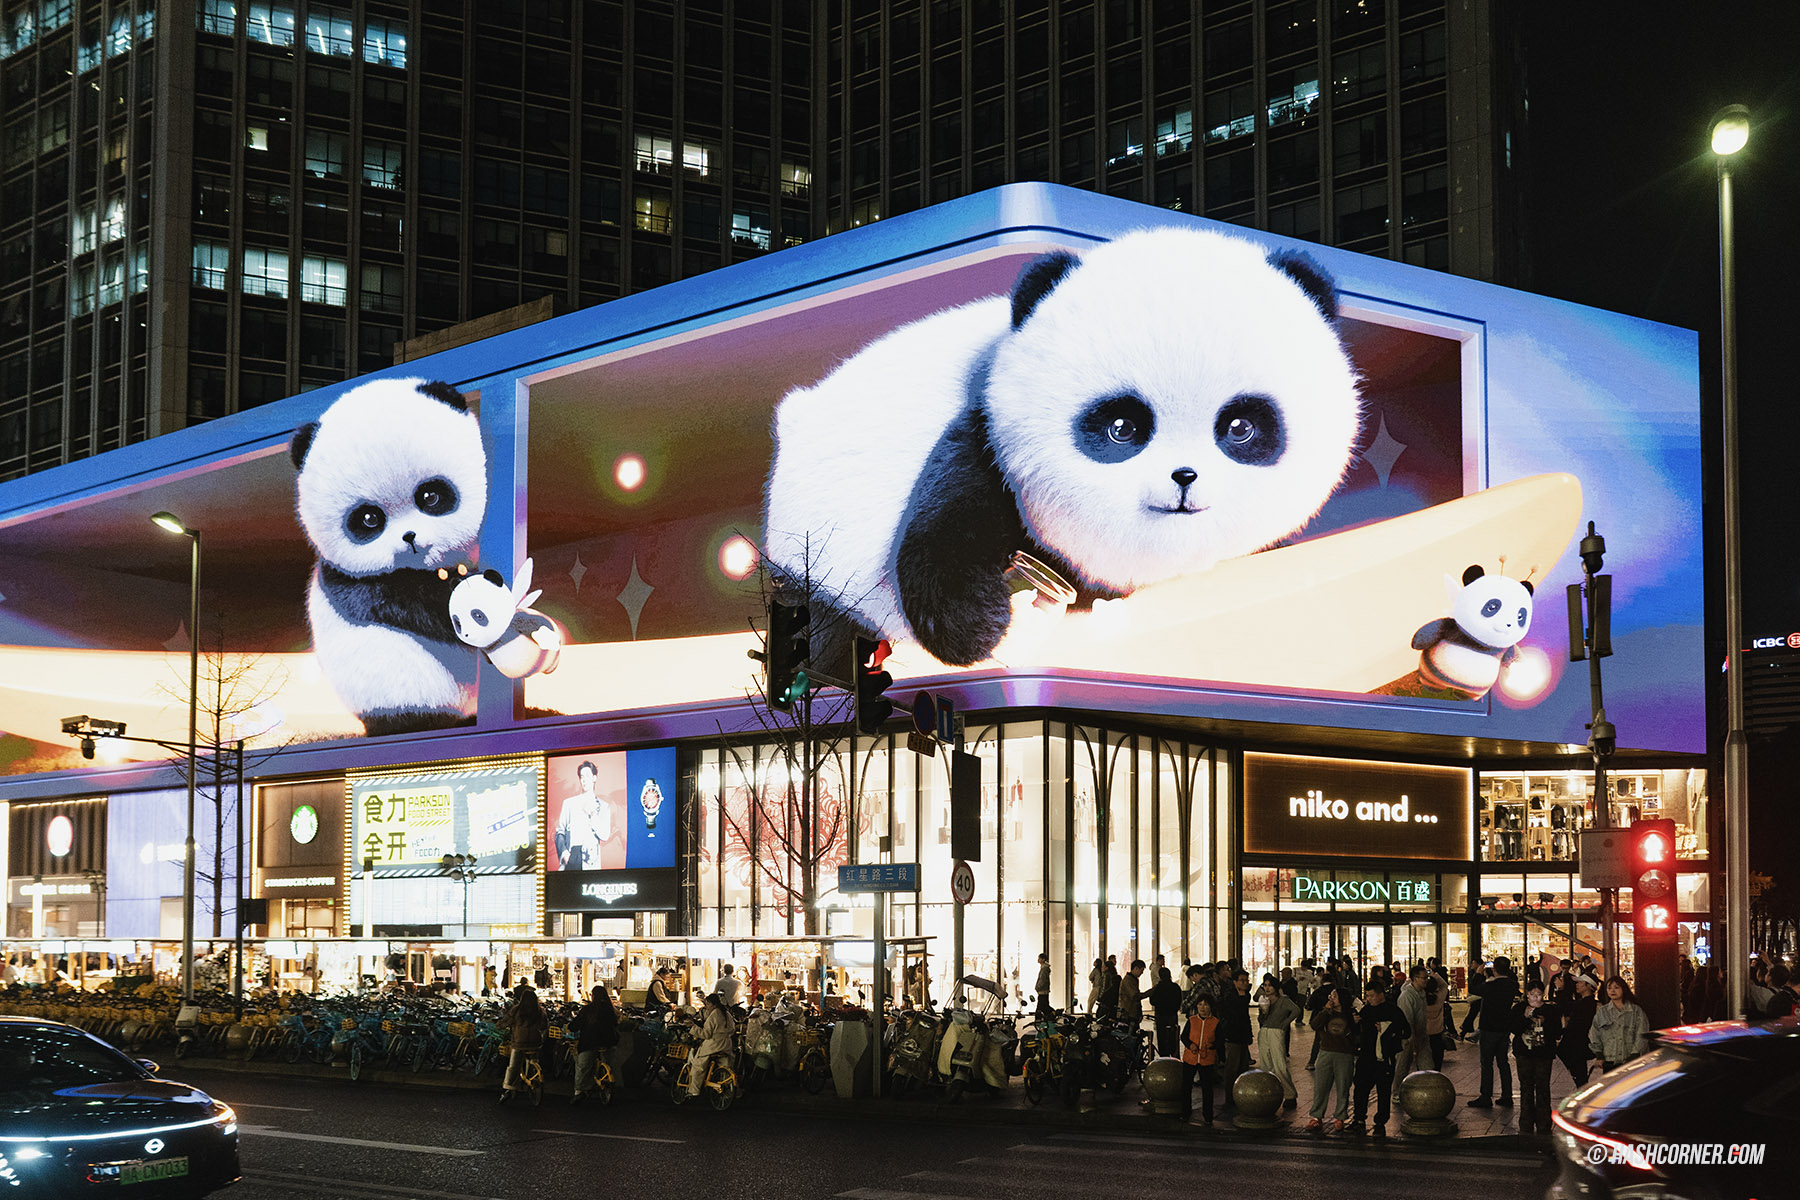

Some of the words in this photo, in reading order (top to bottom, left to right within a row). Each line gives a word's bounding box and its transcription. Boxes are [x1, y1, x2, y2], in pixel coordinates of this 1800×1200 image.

[1753, 637, 1785, 649] ICBC
[363, 793, 406, 824] 食力
[408, 794, 450, 808] PARKSON
[1289, 790, 1349, 820] niko
[1355, 795, 1409, 822] and
[363, 831, 407, 861] 全开
[846, 867, 907, 882] 红星路三段
[956, 874, 971, 892] 40
[581, 882, 638, 896] LONGINES
[1295, 876, 1391, 901] PARKSON
[1395, 880, 1431, 902] 百盛
[1643, 906, 1669, 929] 12
